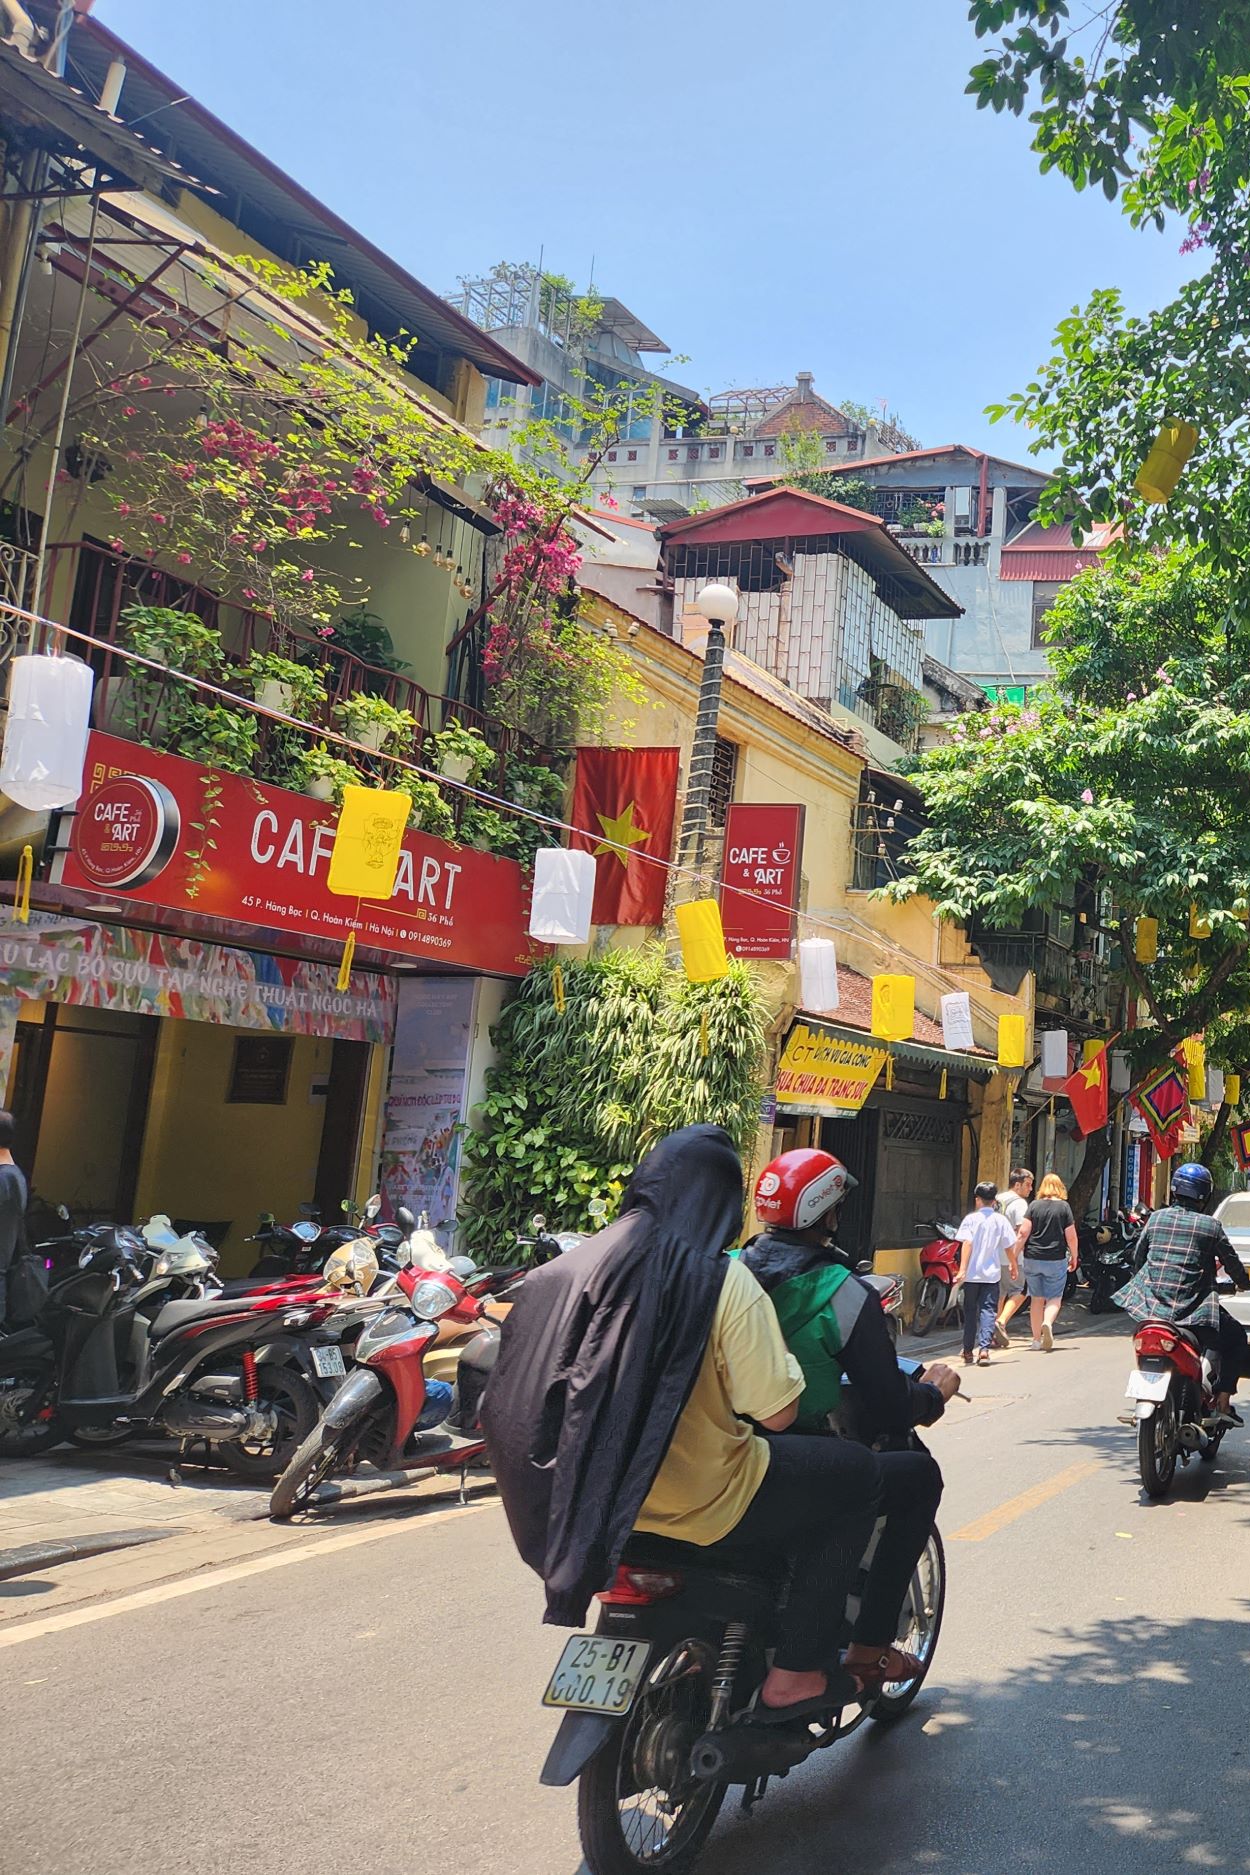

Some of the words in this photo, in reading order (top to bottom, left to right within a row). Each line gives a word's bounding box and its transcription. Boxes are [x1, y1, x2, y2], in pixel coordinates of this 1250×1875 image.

[94, 803, 131, 822] CAFE
[112, 824, 141, 841] ART
[251, 810, 336, 877] CAF
[392, 850, 462, 910] ART
[729, 847, 769, 865] CAFE
[743, 868, 750, 878] &
[754, 868, 784, 885] ART
[242, 895, 254, 907] 45
[255, 899, 263, 909] P.
[265, 900, 287, 917] Hàng
[288, 906, 303, 920] Bạc
[310, 910, 321, 921] Q.
[322, 912, 344, 926] Hoàn
[369, 922, 380, 933] Hà
[381, 925, 395, 938] Nội
[408, 931, 452, 949] 0914890369
[427, 912, 437, 923] 36
[570, 1640, 637, 1673] 25-B1
